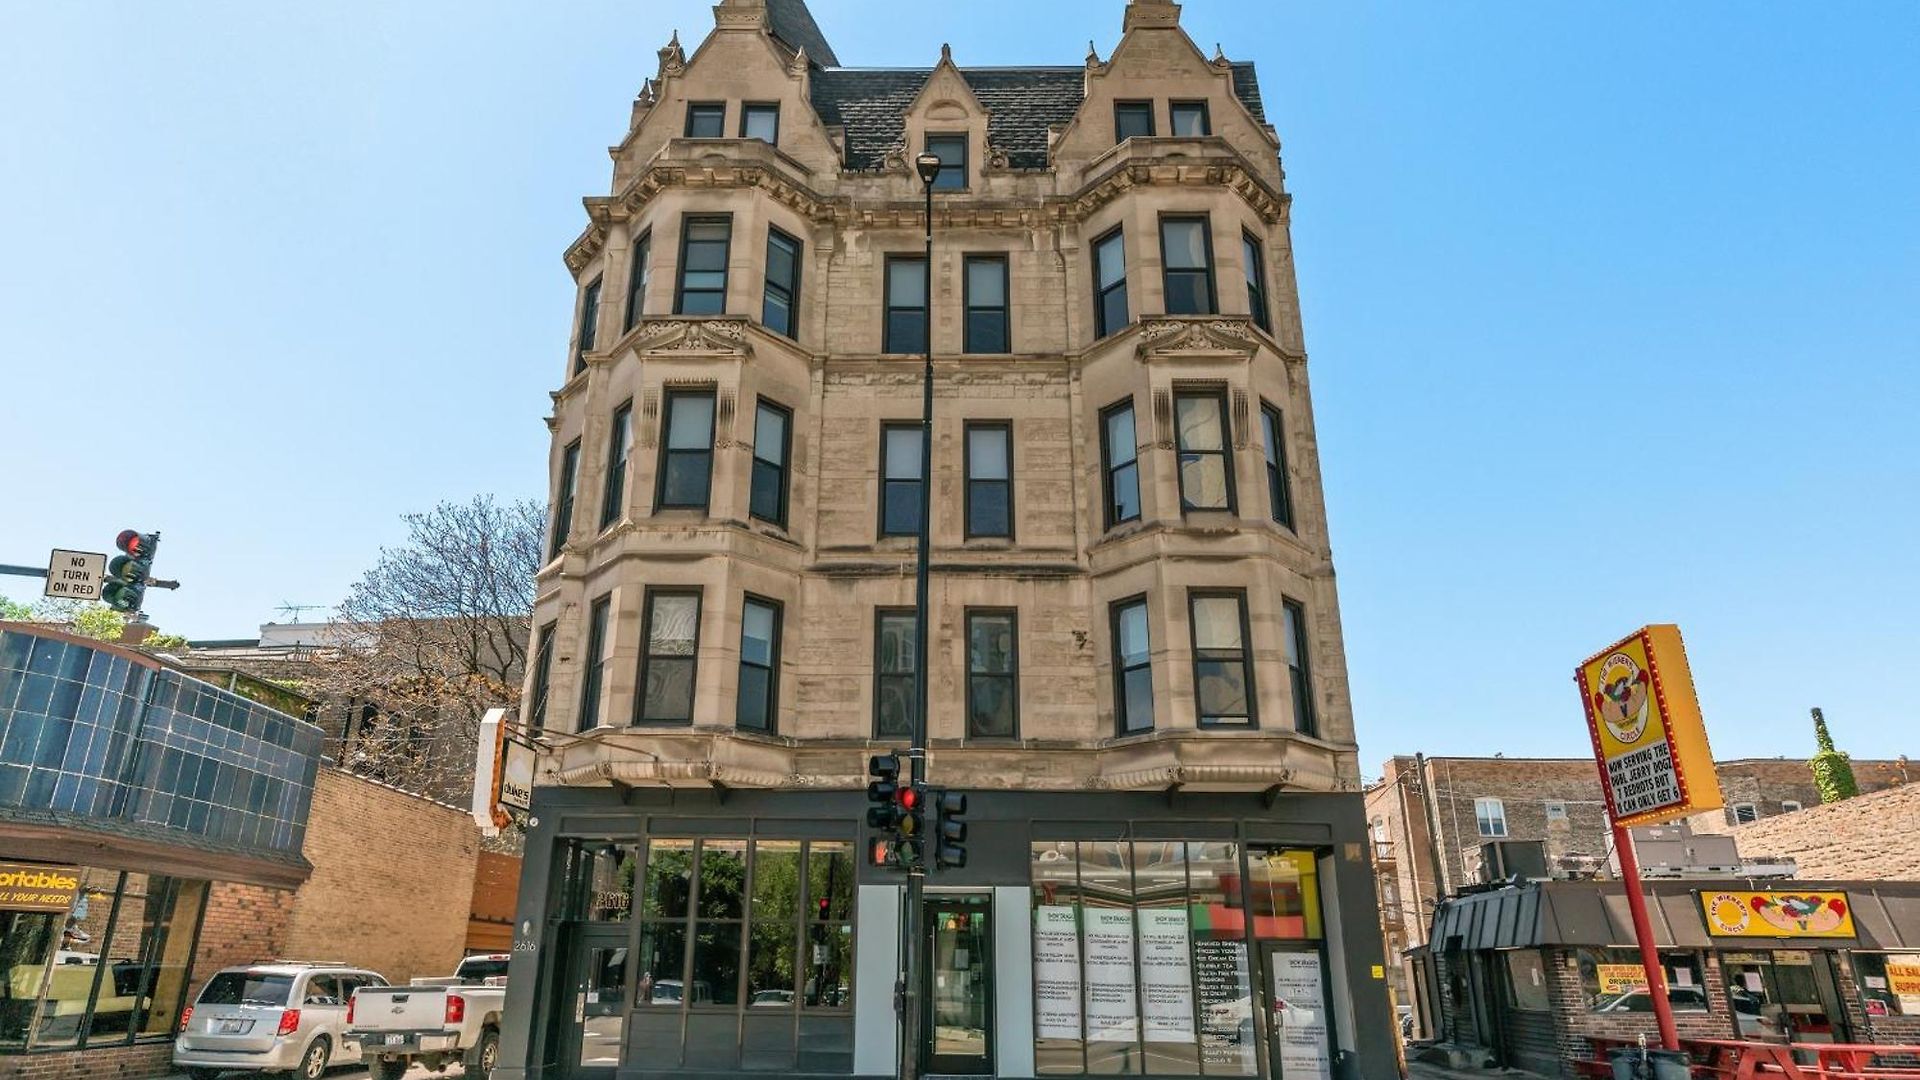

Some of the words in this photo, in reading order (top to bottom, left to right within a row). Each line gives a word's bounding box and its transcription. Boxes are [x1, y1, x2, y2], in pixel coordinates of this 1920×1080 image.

[71, 557, 85, 567] NO
[63, 570, 90, 581] TURN
[53, 582, 68, 592] ON
[72, 584, 94, 594] RED
[1620, 728, 1641, 741] CIRCLE
[1608, 760, 1623, 774] NOW
[1624, 749, 1653, 769] SERVING
[1653, 743, 1669, 758] THE
[1630, 763, 1652, 781] JERRY
[1653, 757, 1673, 773] DOGZ
[1623, 778, 1655, 798] REDHOTS
[1655, 773, 1670, 788] BUT
[1624, 798, 1637, 812] CAN
[1638, 793, 1656, 808] ONLY
[1657, 788, 1671, 803] GET
[1673, 787, 1679, 799] 6
[0, 871, 77, 890] ortables
[11, 893, 38, 903] YOUR
[39, 894, 72, 904] NEEDS
[1720, 923, 1746, 933] CIRCLE
